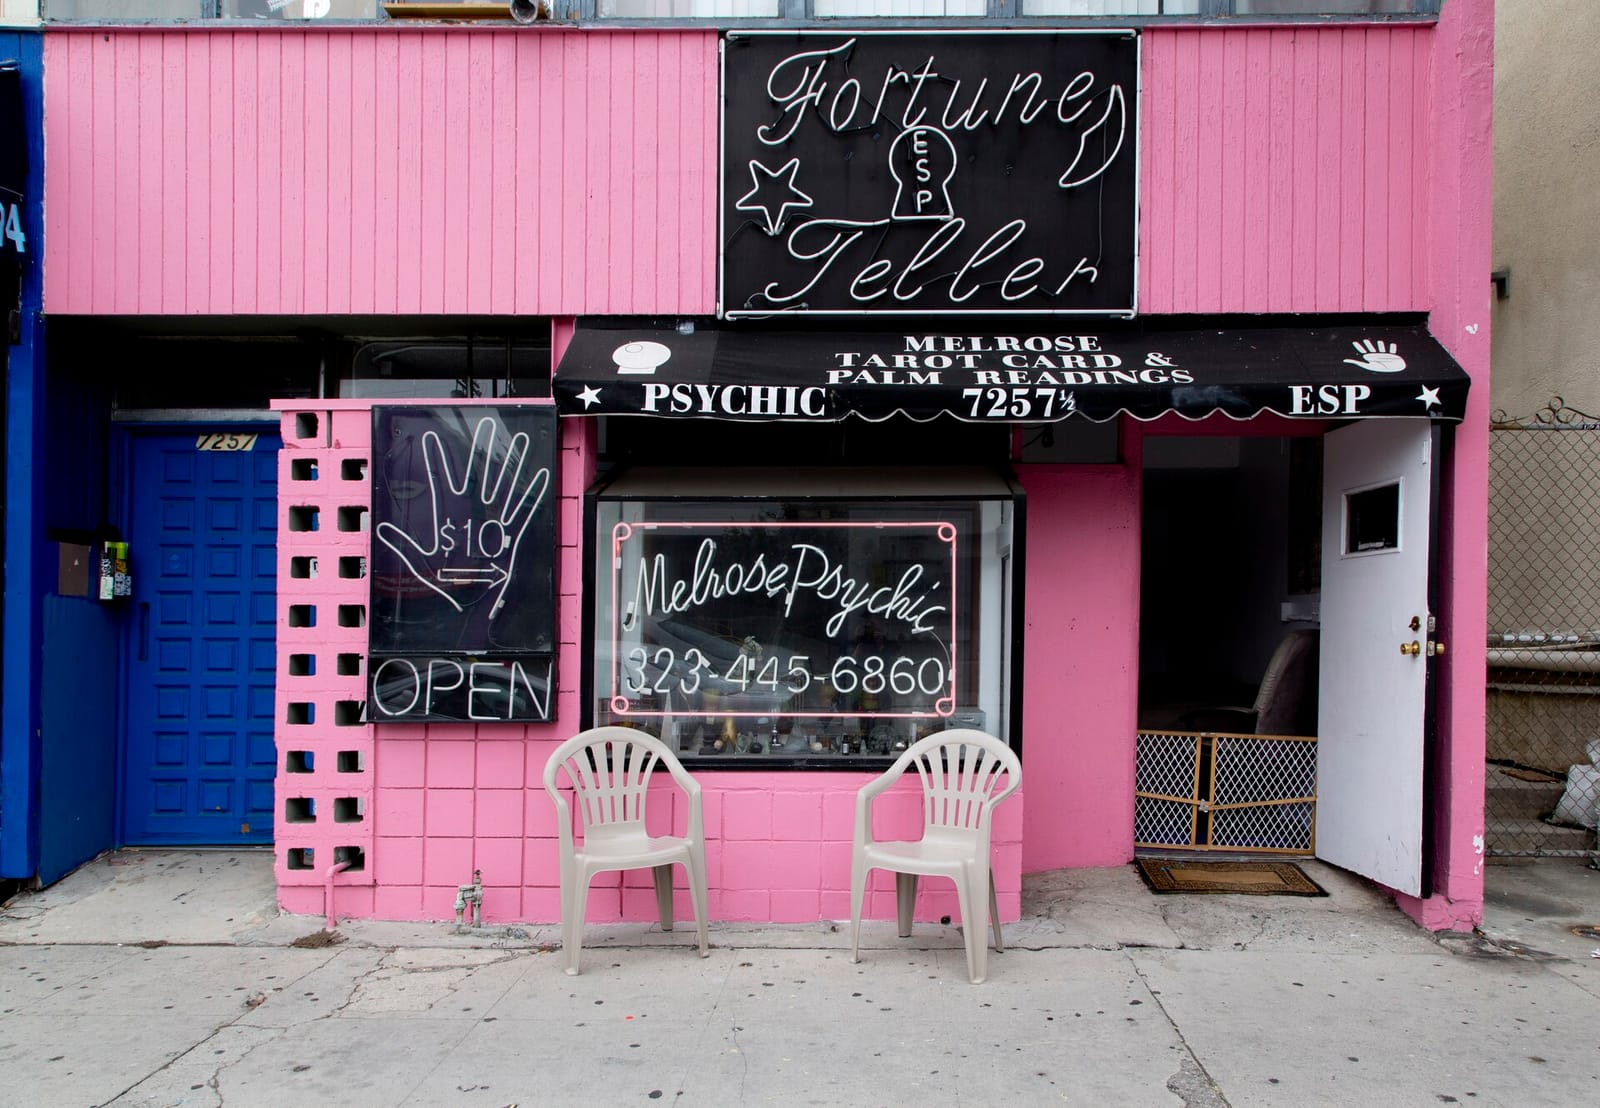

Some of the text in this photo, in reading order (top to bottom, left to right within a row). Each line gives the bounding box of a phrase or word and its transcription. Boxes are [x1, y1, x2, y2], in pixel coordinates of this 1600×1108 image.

[758, 38, 1095, 145] Fortune
[912, 130, 934, 213] ESP
[764, 218, 1099, 302] Teller
[834, 352, 1179, 369] TAROT CARD &
[903, 335, 1102, 352] MELROSE
[825, 369, 1194, 385] PALM READINGS
[640, 383, 826, 417] PSYCHIC
[1288, 384, 1371, 415] ESP
[198, 433, 257, 450] 7257
[440, 518, 506, 558] $10
[623, 538, 946, 637] Melrose Psychic
[373, 658, 552, 720] OPEN
[626, 647, 943, 694] 323-445-6860
